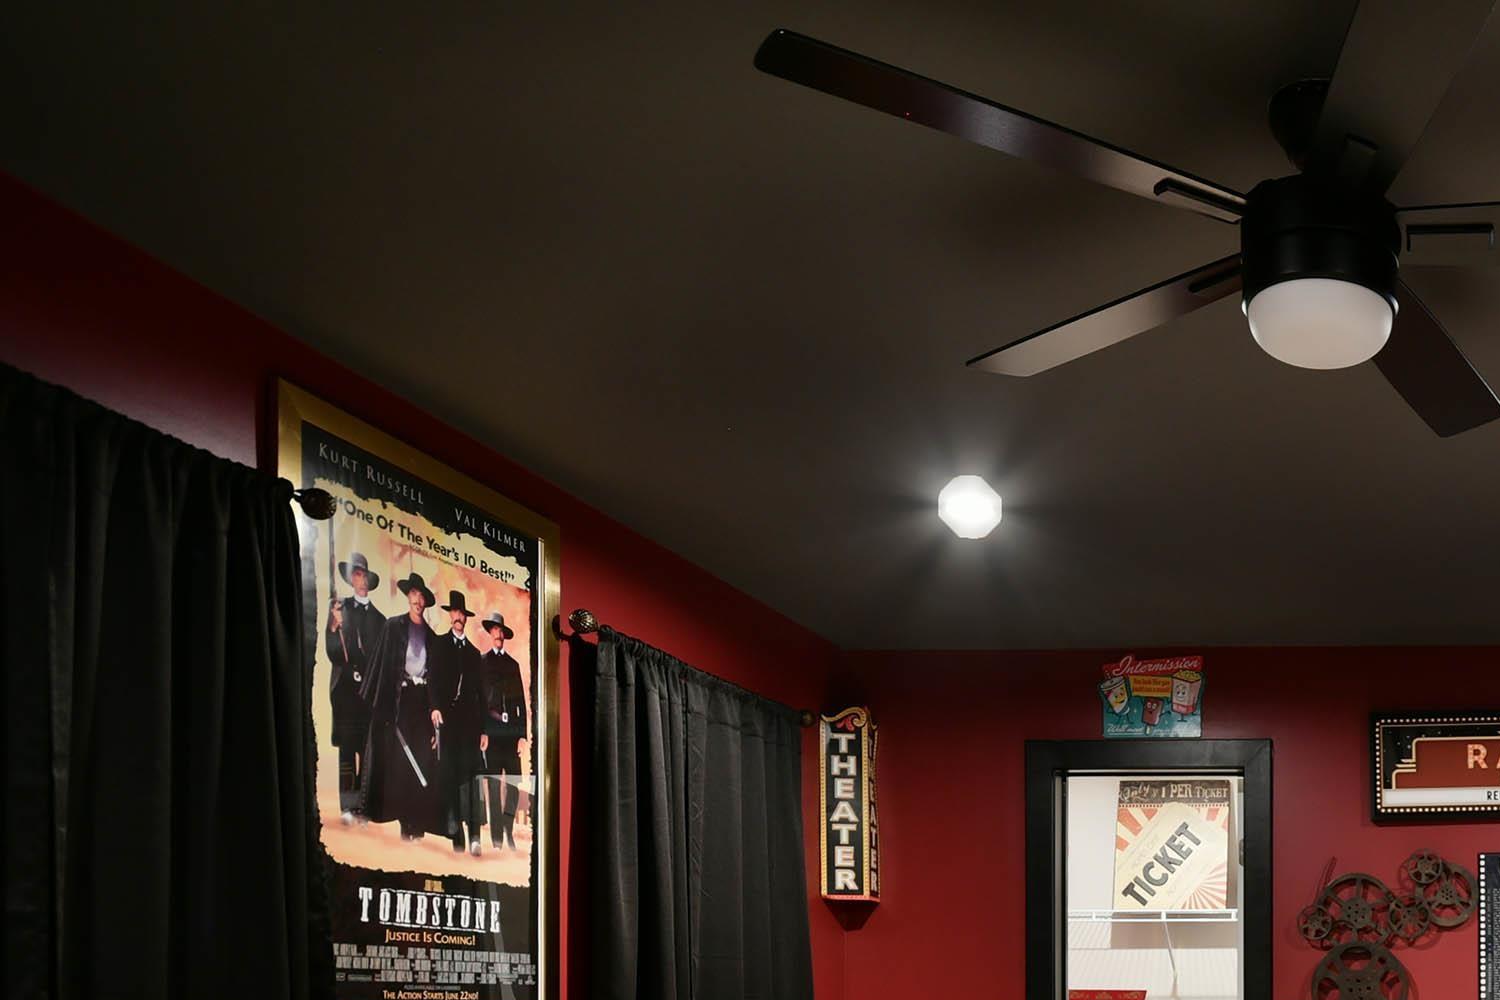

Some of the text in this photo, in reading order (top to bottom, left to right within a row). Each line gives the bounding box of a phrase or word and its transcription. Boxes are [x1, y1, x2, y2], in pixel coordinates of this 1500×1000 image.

[318, 442, 424, 505] KURT RUSSELL
[376, 515, 396, 533] Of
[398, 524, 424, 547] The
[426, 536, 460, 563] Year's
[463, 552, 476, 570] 10
[454, 508, 527, 553] VAL KILMER
[1112, 655, 1199, 676] Intermission
[829, 732, 859, 890] THEATER
[1170, 783, 1193, 798] PER
[1197, 787, 1229, 799] TICKET
[1121, 821, 1202, 907] TICKET
[359, 886, 501, 933] TOMBSTONE
[382, 989, 397, 1000] THE
[397, 989, 422, 1000] ACTION
[423, 989, 443, 1000] STARTS
